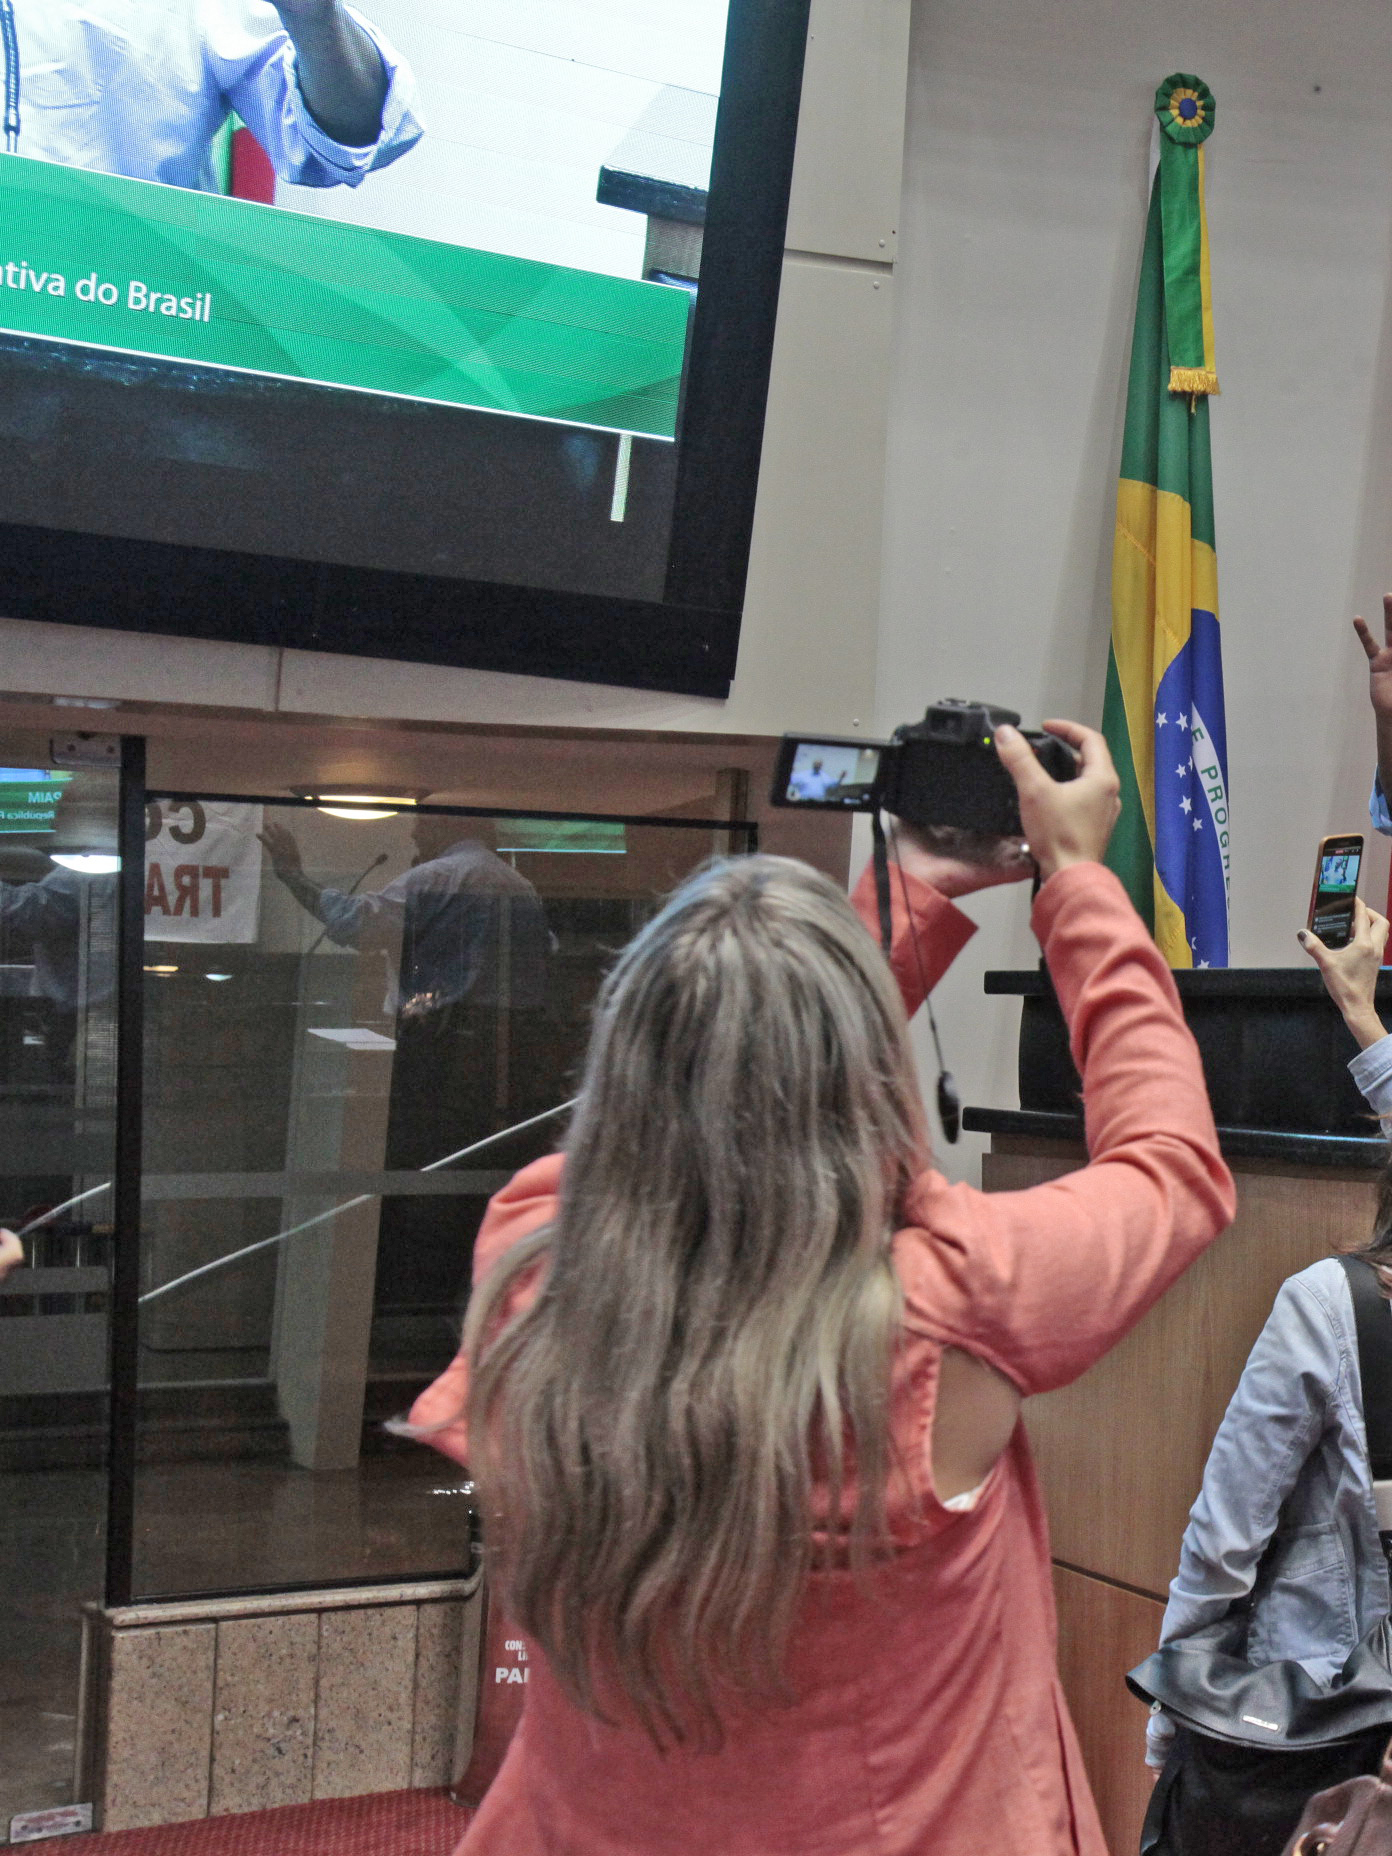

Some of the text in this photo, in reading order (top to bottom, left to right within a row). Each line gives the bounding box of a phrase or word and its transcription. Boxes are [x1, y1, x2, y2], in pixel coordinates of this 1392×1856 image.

[0, 260, 212, 323] tiva do Brasil
